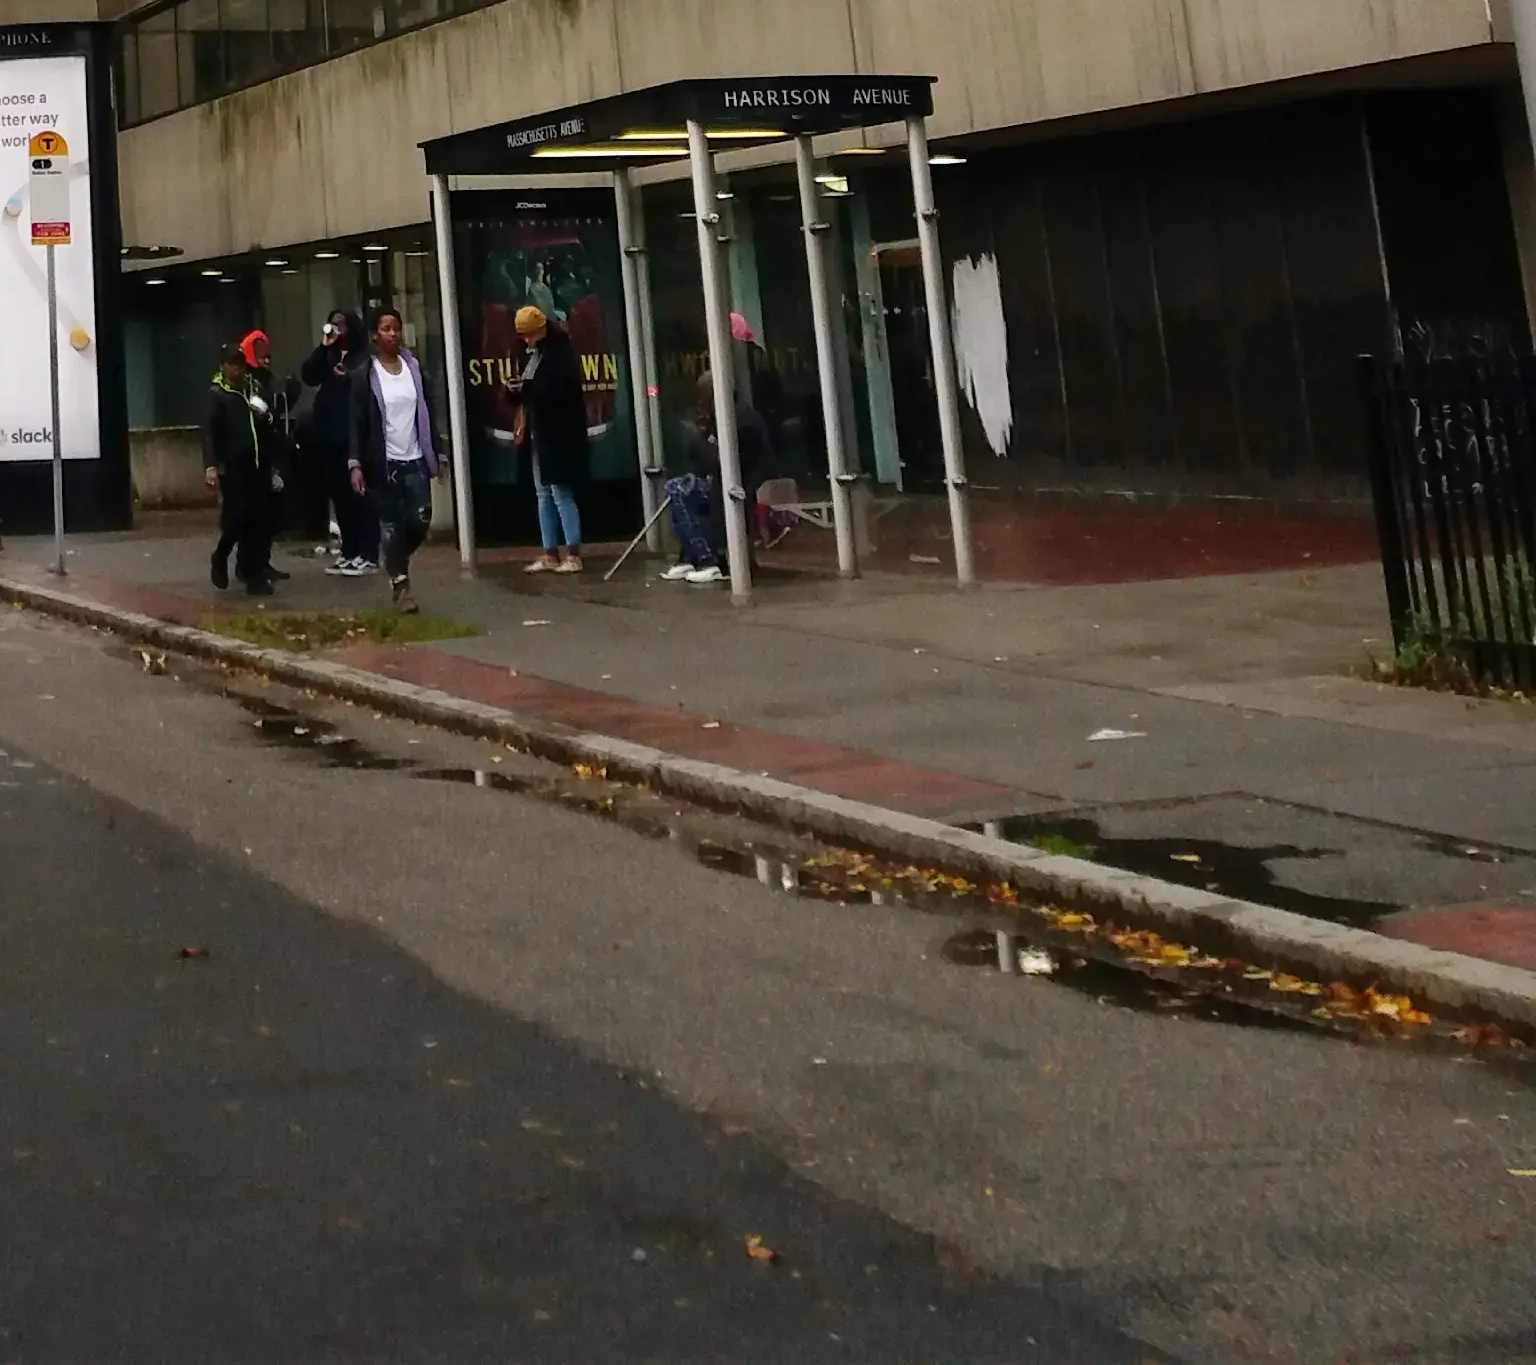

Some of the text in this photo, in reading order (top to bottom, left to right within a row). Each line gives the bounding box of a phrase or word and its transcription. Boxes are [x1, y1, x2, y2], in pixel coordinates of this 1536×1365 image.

[39, 93, 47, 104] a
[724, 88, 912, 108] HARRISON AVENUE
[30, 113, 59, 127] way
[506, 124, 558, 148] MASSACHUSETTS
[11, 427, 52, 444] slack
